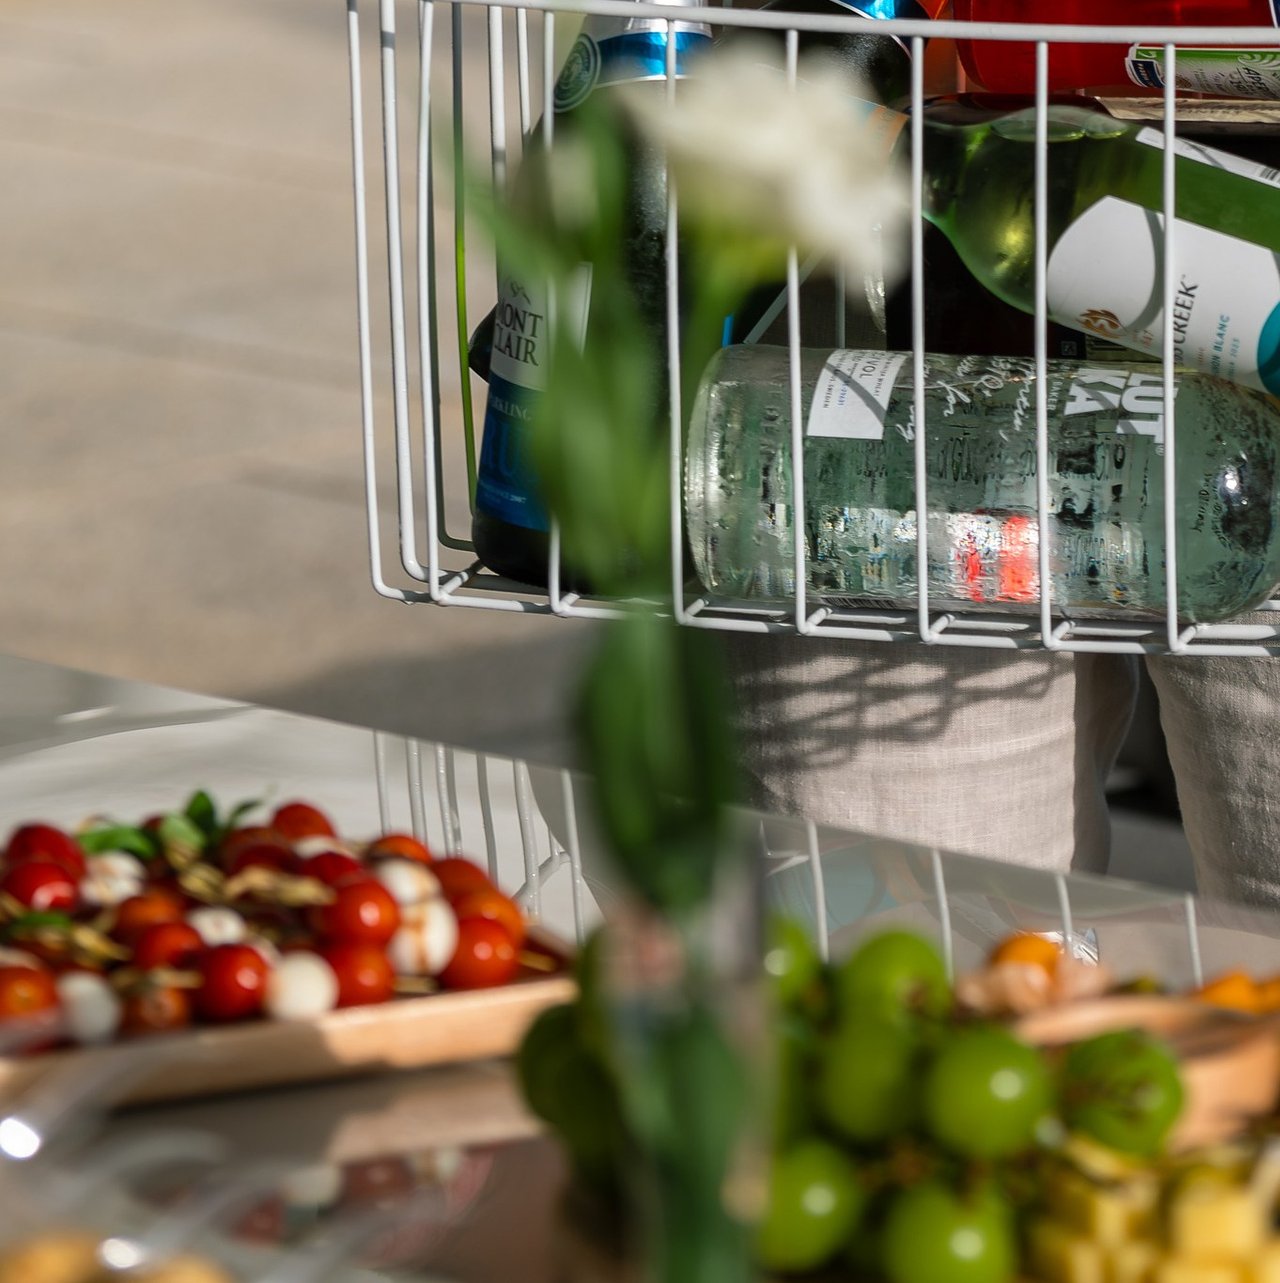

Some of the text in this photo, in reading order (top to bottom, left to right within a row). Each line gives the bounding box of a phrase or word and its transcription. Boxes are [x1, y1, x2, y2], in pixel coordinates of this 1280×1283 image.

[1173, 281, 1198, 347] CREEK
[1213, 313, 1230, 353] BLANC
[494, 323, 539, 366] LAIR
[936, 380, 971, 417] for
[1047, 381, 1063, 411] BAKER
